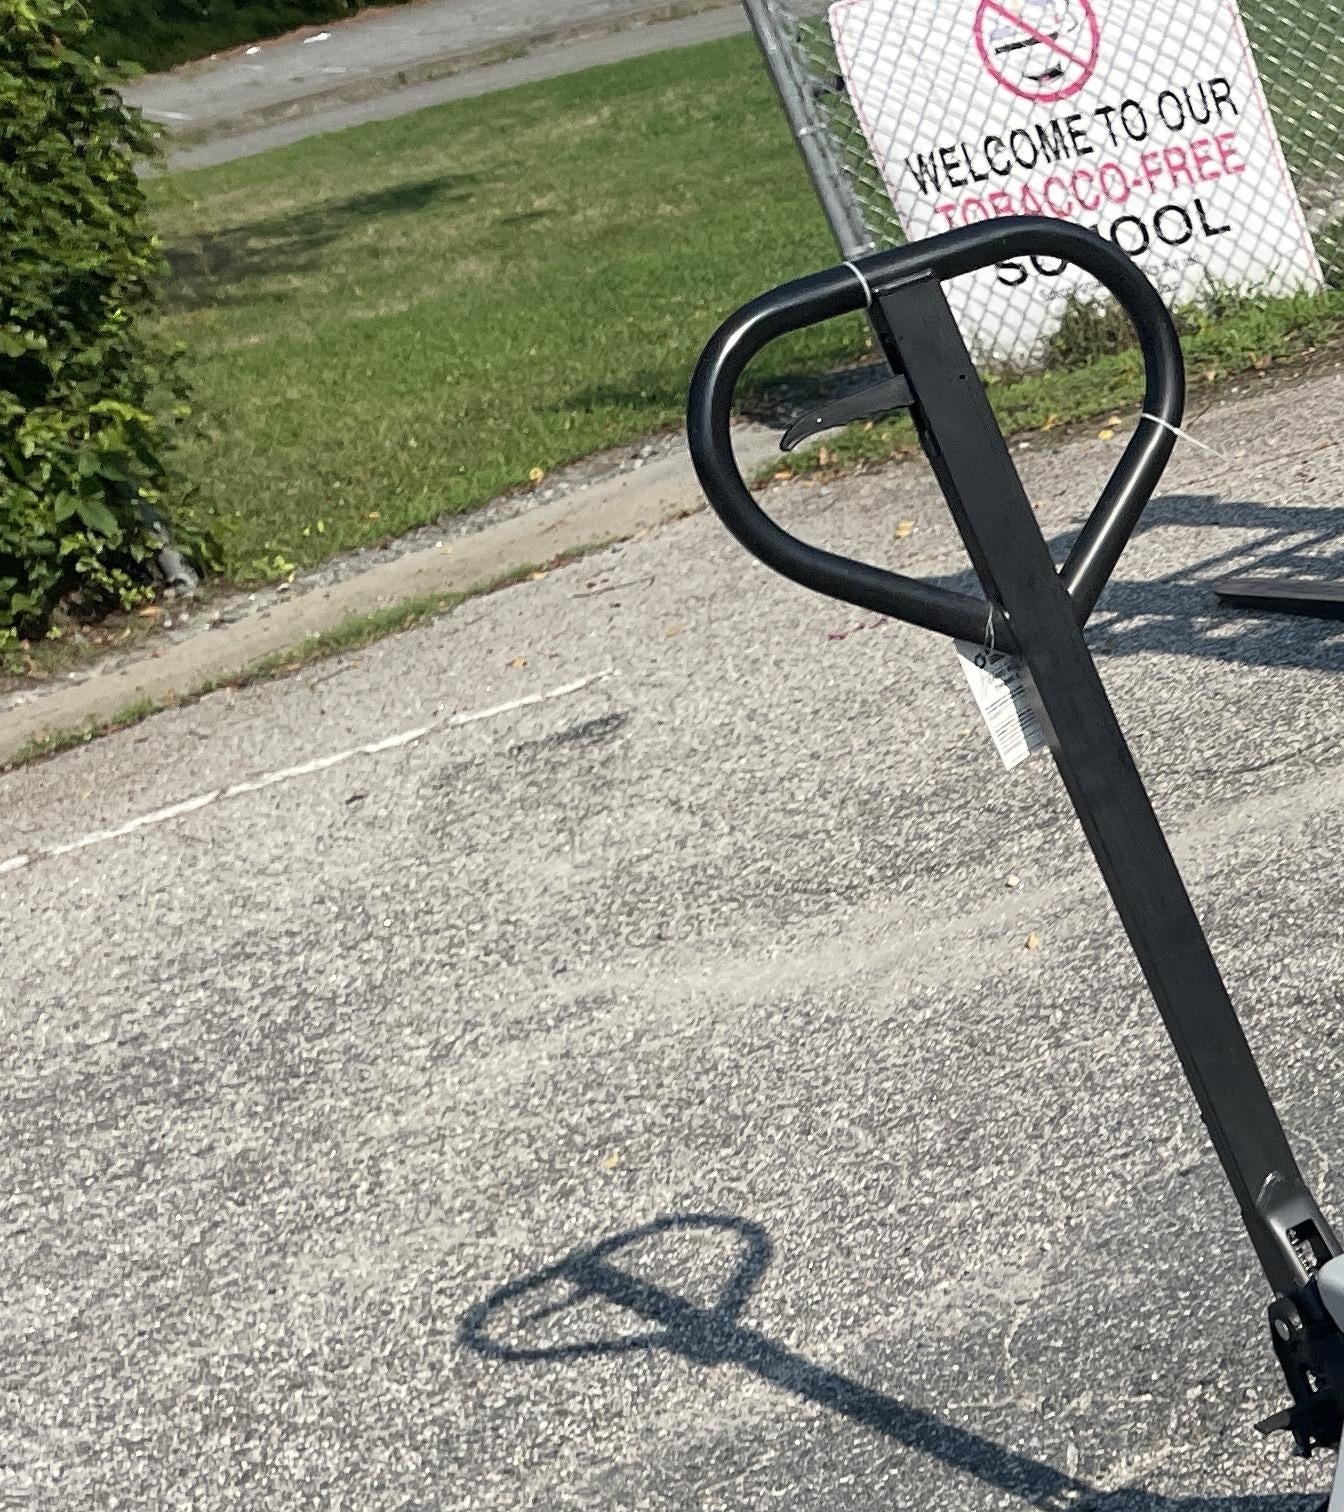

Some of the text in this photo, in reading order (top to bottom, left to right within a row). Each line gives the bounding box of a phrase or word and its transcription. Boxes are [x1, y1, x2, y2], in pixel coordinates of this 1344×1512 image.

[904, 77, 1239, 196] WELCOME TO OUR
[935, 132, 1246, 234] TOBACCO-FREE
[996, 198, 1231, 287] SCOOL
